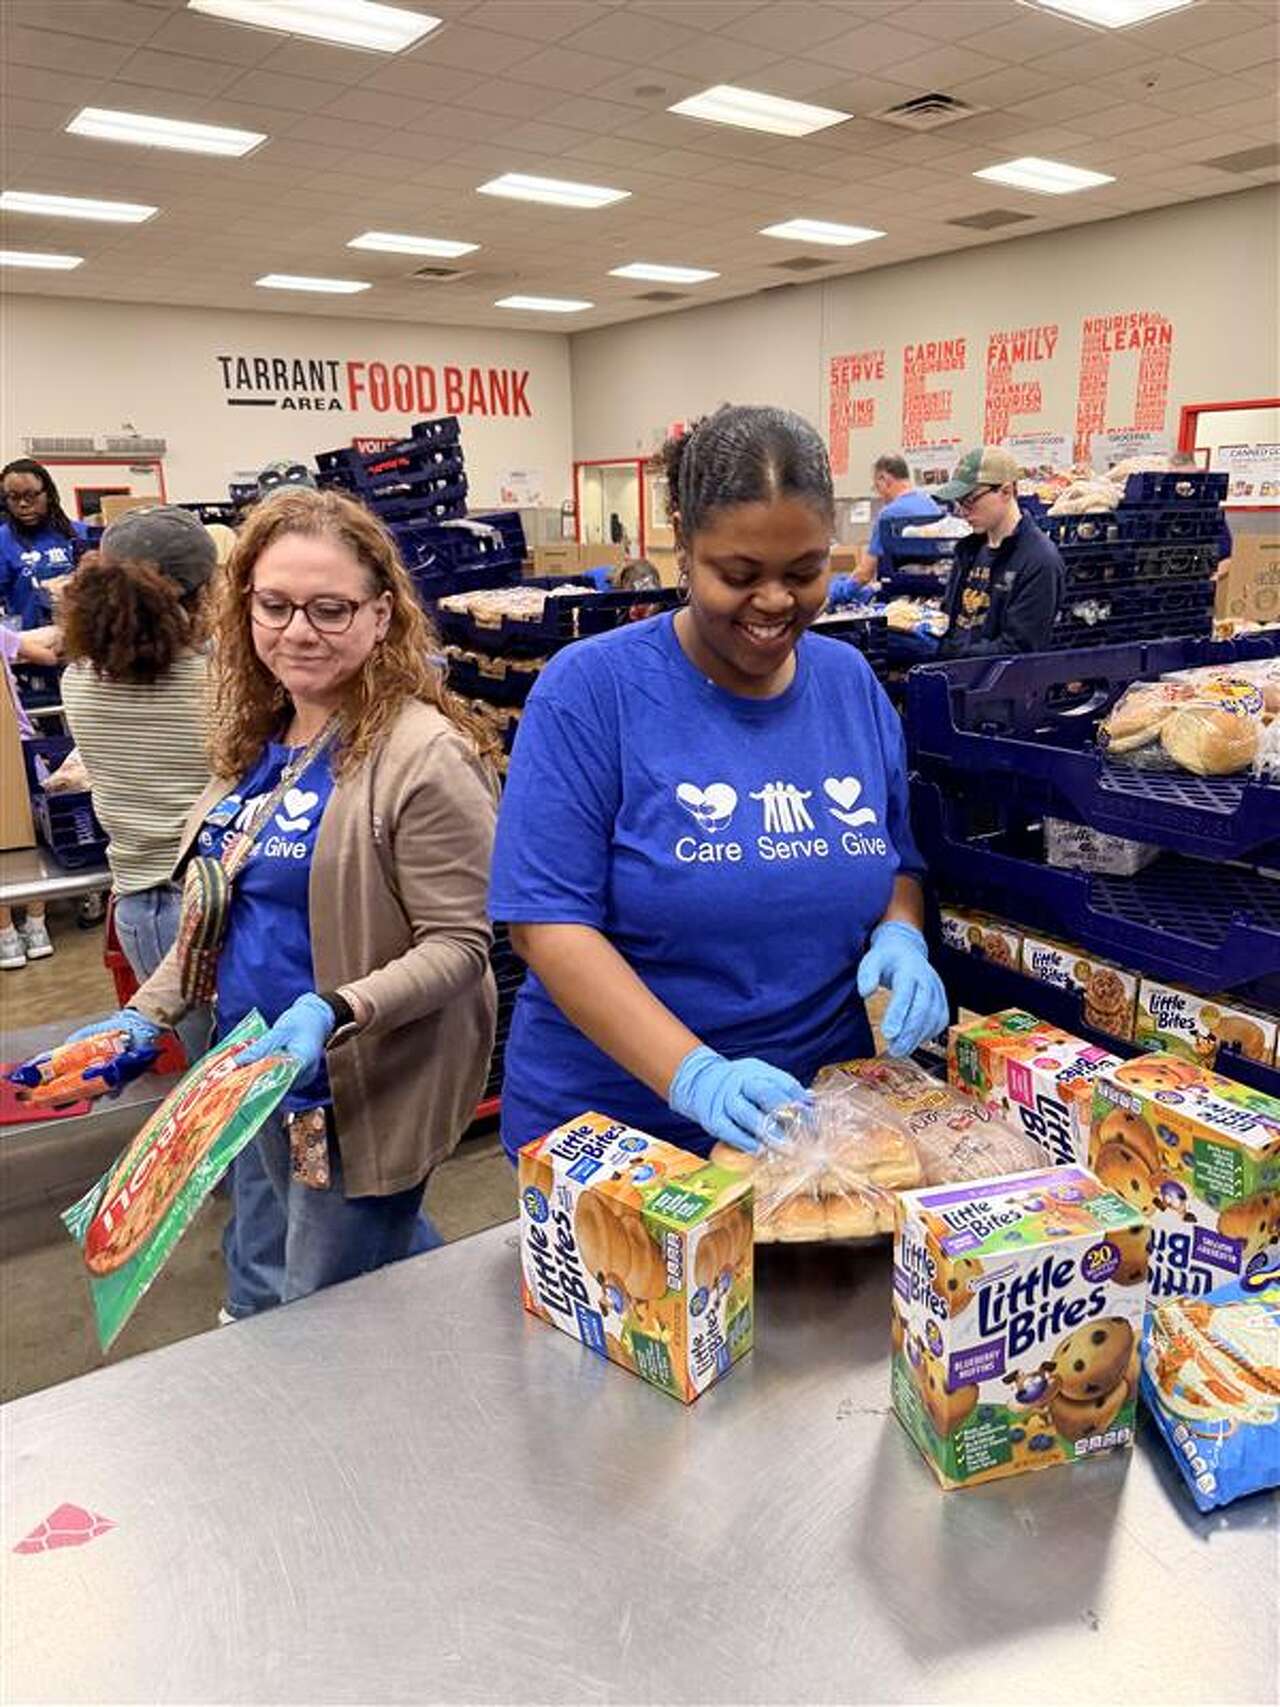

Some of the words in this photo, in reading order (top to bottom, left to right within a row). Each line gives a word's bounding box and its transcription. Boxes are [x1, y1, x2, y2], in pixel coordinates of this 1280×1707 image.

[904, 338, 966, 363] CARING
[988, 337, 1057, 364] FAMILY
[1102, 324, 1172, 352] LEARN
[217, 356, 340, 392] TARRANT
[831, 361, 885, 385] SERVE
[281, 396, 343, 411] AREA
[346, 362, 436, 414] FOOD
[444, 366, 533, 417] BANK
[264, 836, 307, 859] Give
[676, 836, 742, 862] Care
[757, 835, 829, 859] Serve
[841, 831, 887, 856] Give
[1031, 950, 1063, 969] Little
[1040, 966, 1070, 984] Bites
[1149, 994, 1186, 1015] Little
[1157, 1009, 1196, 1030] Bites
[102, 1056, 239, 1232] BOBOLI
[549, 1125, 594, 1162] Little
[581, 1124, 628, 1160] Bites
[1036, 1094, 1077, 1165] Littl
[942, 1200, 993, 1232] Little
[970, 1208, 1023, 1239] Bites
[549, 1208, 591, 1306] Bites
[902, 1232, 936, 1279] Little
[1088, 1245, 1112, 1268] 20
[1146, 1229, 1191, 1268] Bit
[525, 1224, 574, 1317] Little
[911, 1272, 948, 1321] Bites
[977, 1256, 1075, 1338] Little
[1008, 1286, 1107, 1359] Bites
[954, 1348, 1001, 1372] BLUEBERRY
[959, 1362, 995, 1379] MUFFINS
